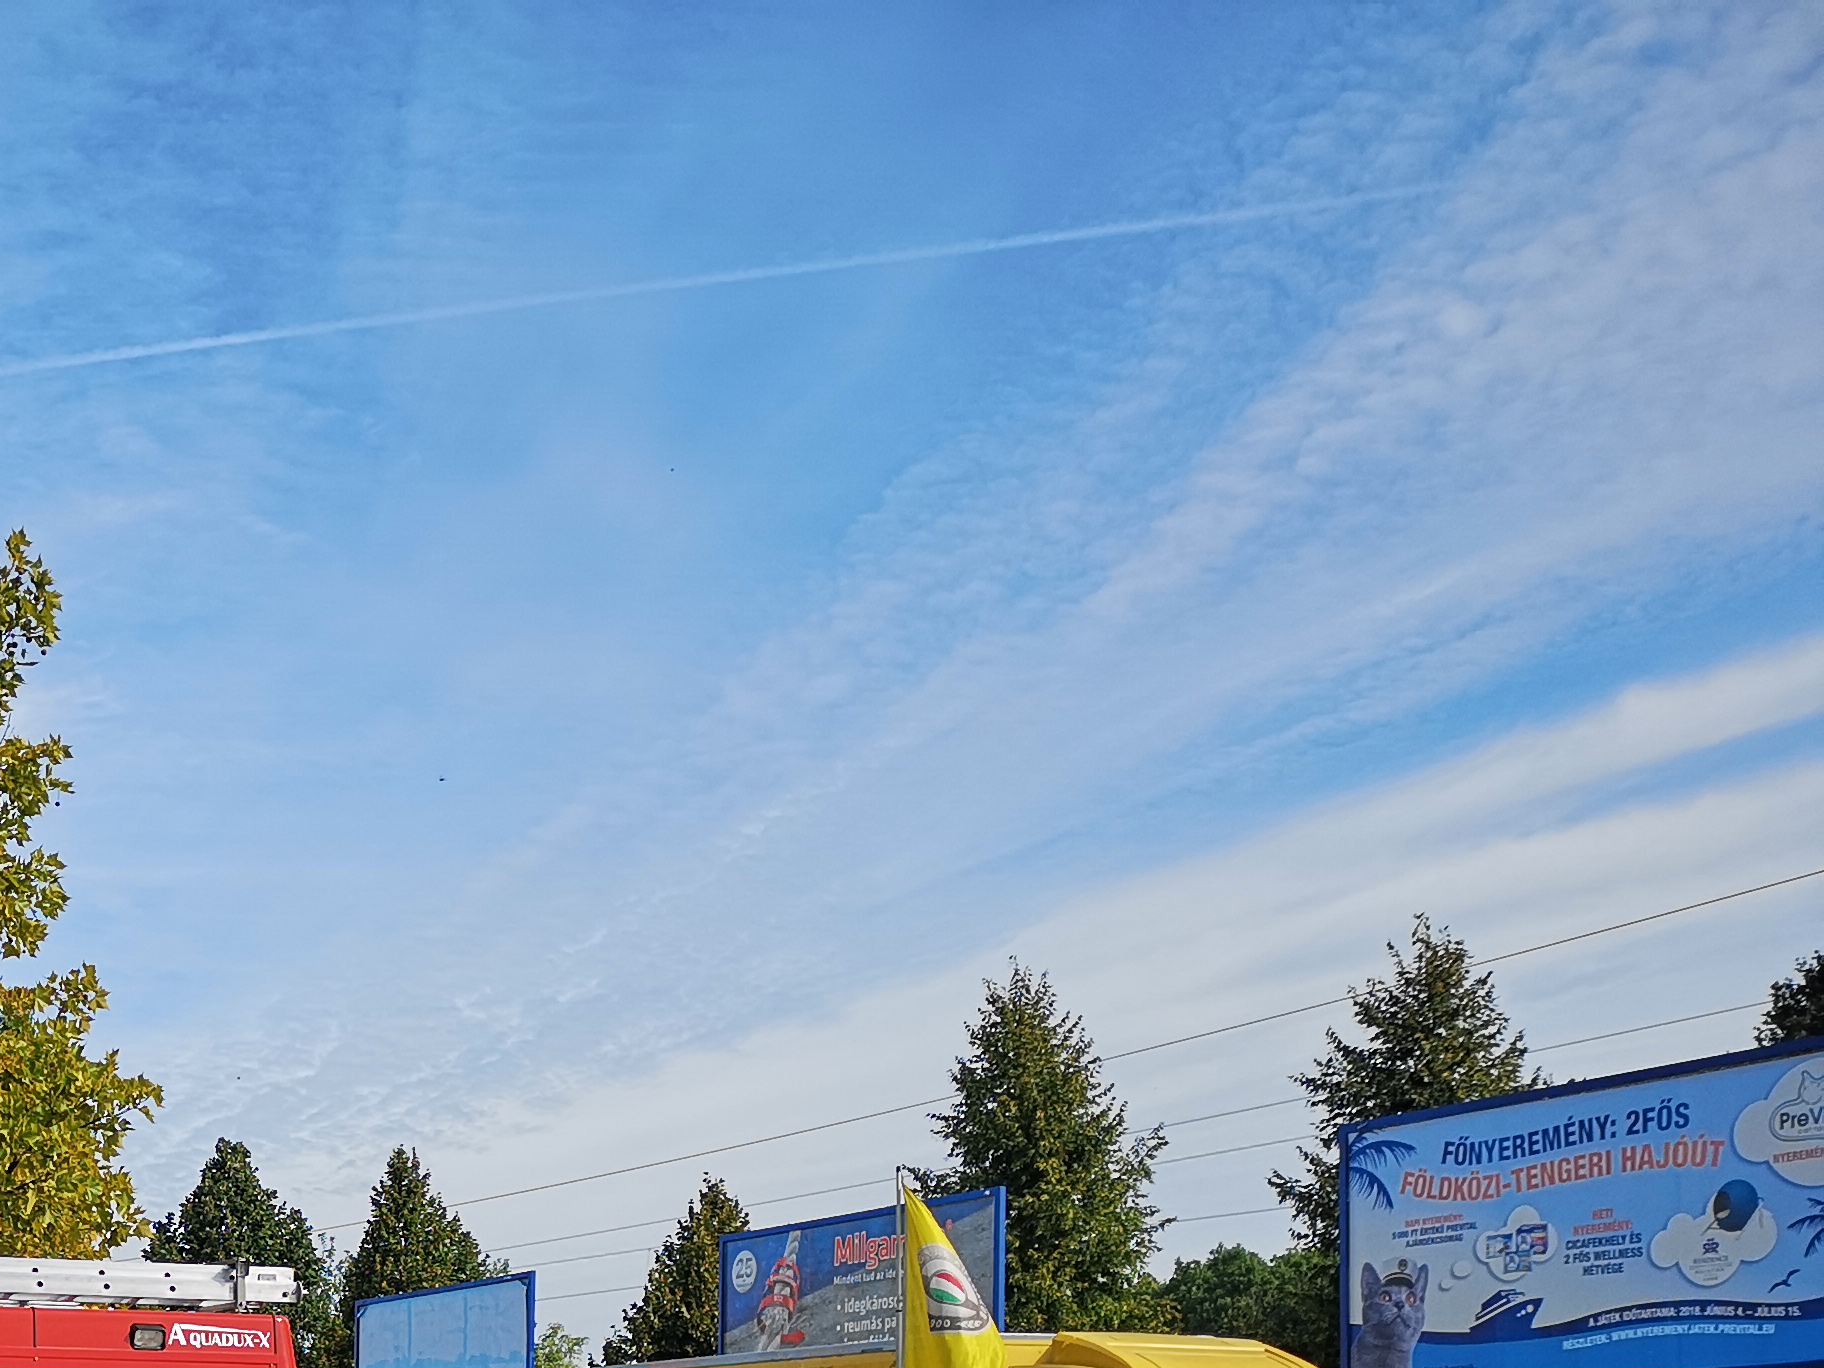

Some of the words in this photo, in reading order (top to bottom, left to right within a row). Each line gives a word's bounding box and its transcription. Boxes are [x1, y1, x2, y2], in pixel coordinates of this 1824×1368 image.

[1440, 1113, 1618, 1167] FŐNYEREMÉNY:
[1626, 1098, 1690, 1137] 2FŐS
[1399, 1150, 1613, 1202] FÖLDKÖZI-TENGERI
[1621, 1133, 1725, 1174] HAJÓÚT
[1565, 1234, 1629, 1250] CICAFEKHELY
[1629, 1231, 1643, 1245] ÉS
[1563, 1253, 1571, 1265] 2
[1593, 1246, 1644, 1262] WELLNESS
[736, 1257, 753, 1279] 25
[844, 1315, 883, 1333] reumás
